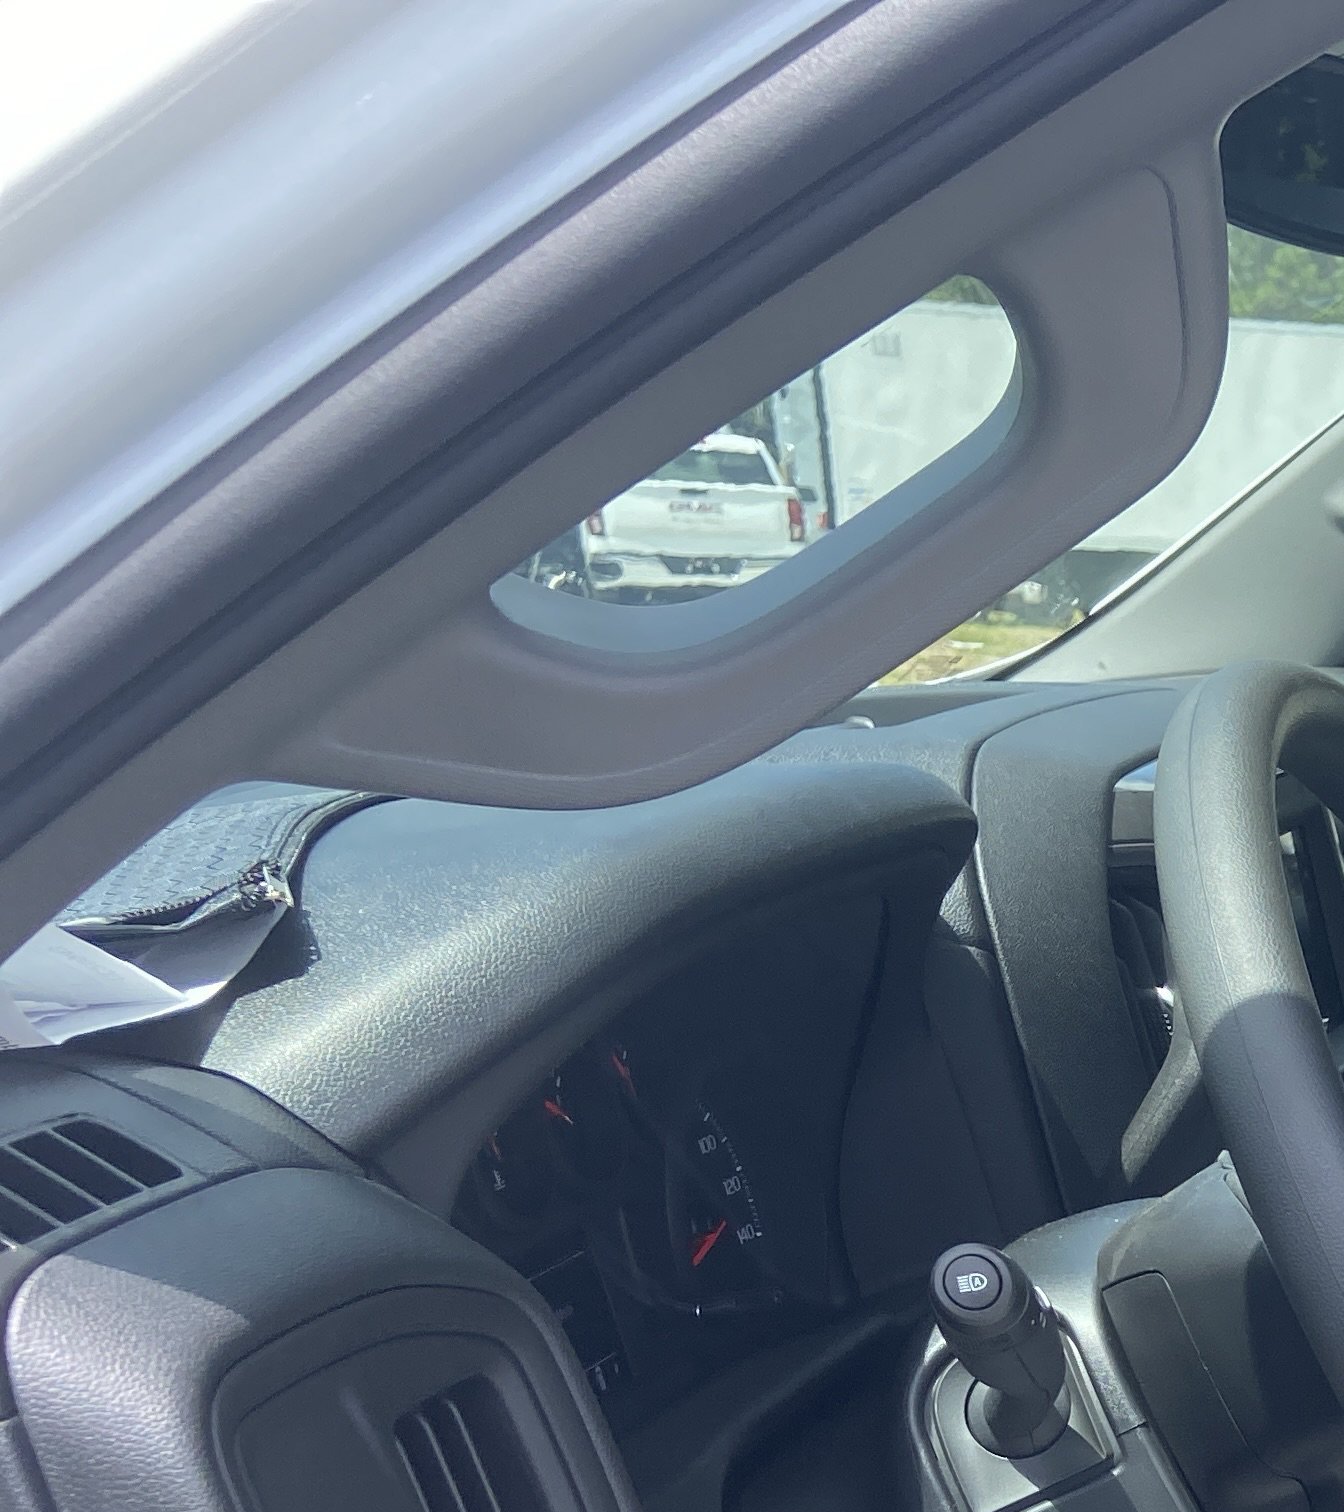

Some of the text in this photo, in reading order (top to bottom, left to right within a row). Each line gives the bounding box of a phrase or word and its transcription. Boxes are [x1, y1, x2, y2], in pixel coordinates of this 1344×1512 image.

[696, 1133, 718, 1155] 100
[722, 1175, 742, 1196] 120
[736, 1223, 756, 1245] 140
